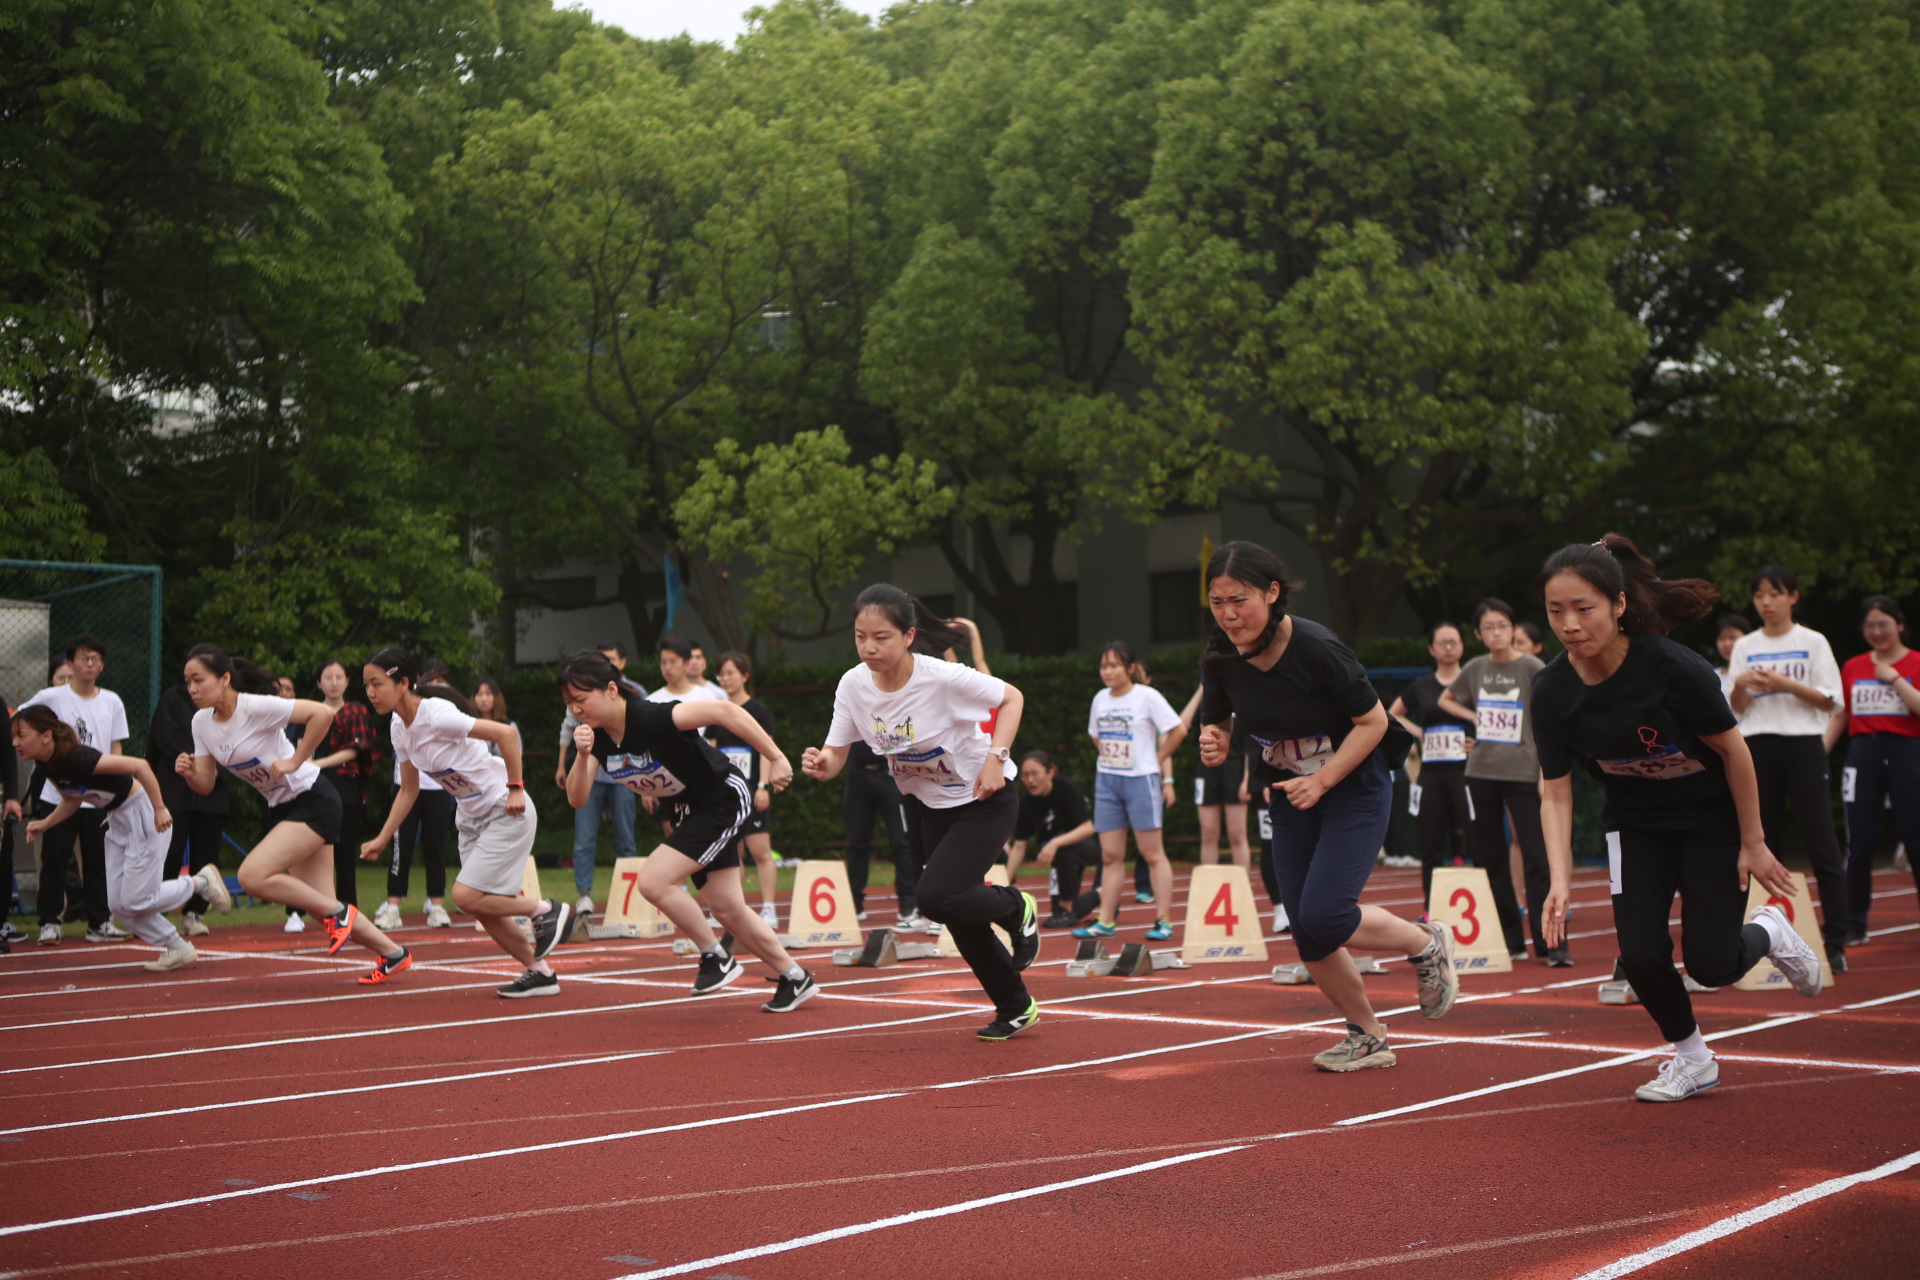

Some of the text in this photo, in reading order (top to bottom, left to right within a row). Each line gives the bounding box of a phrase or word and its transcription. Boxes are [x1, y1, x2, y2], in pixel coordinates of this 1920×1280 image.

[622, 872, 638, 916] 7
[809, 876, 836, 924] 6
[1204, 883, 1239, 936] 4
[1449, 888, 1481, 945] 3
